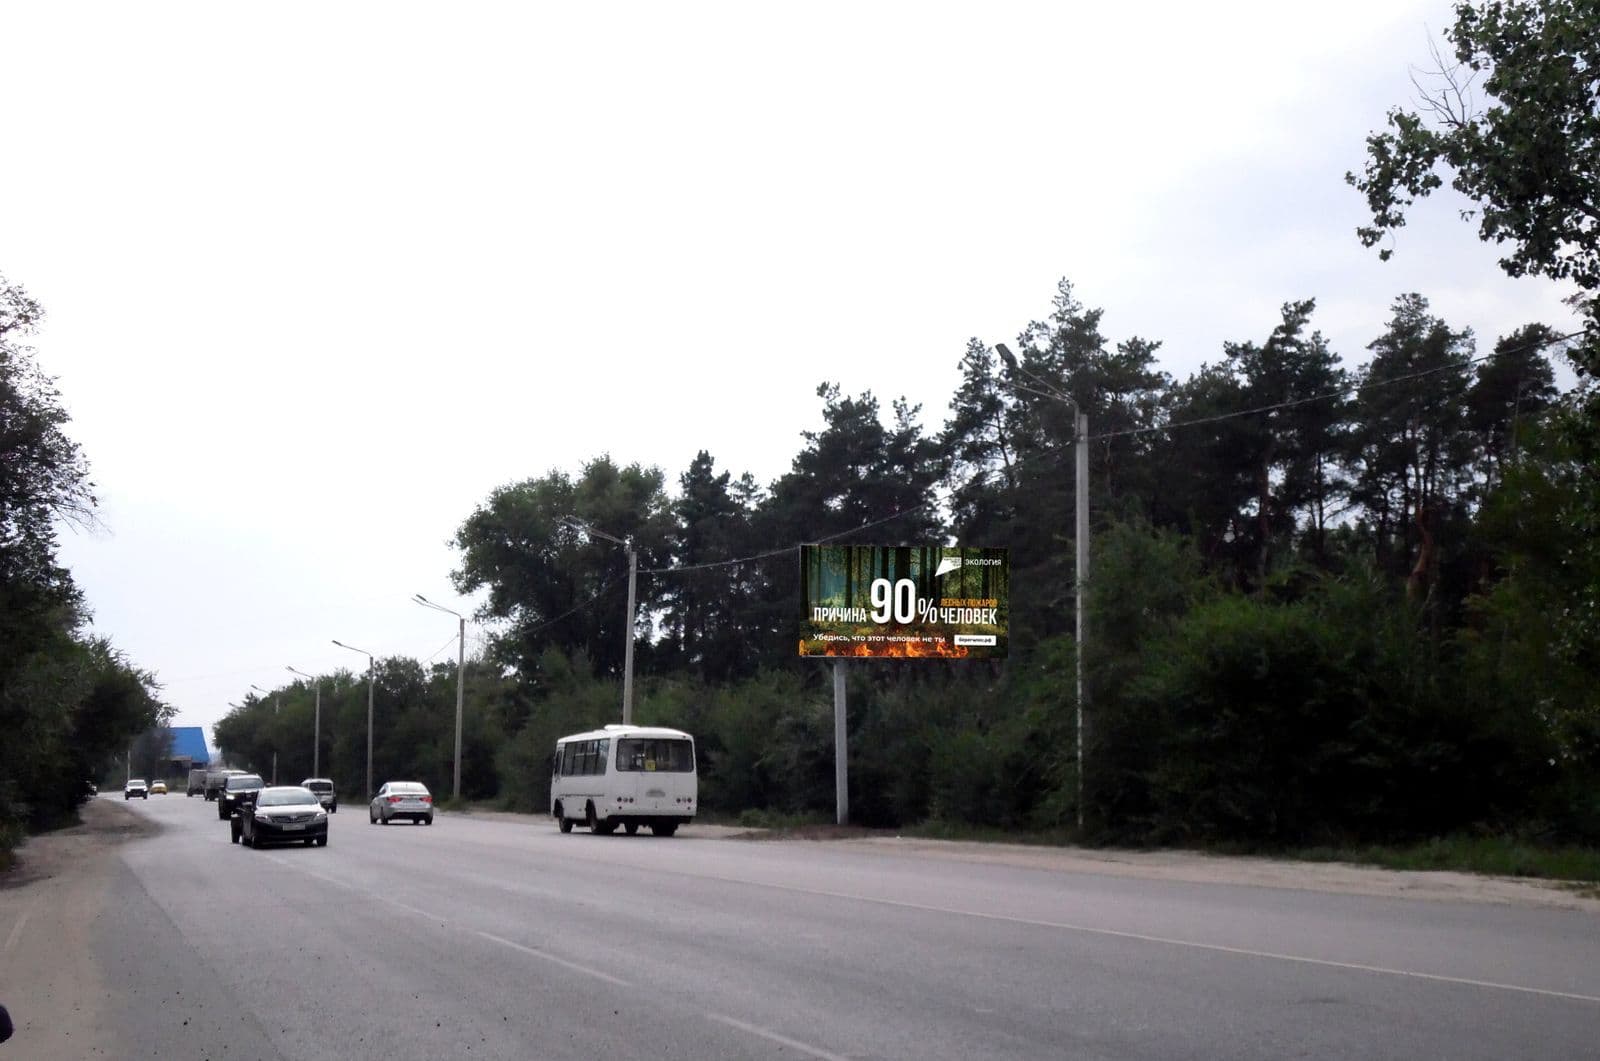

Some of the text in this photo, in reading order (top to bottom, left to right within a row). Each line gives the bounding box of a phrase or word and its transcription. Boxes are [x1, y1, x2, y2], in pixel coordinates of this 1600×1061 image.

[813, 607, 867, 622] ПРИЧИНА
[940, 607, 998, 625] ЧЕЛОВЕК
[812, 633, 850, 642] Убедись,
